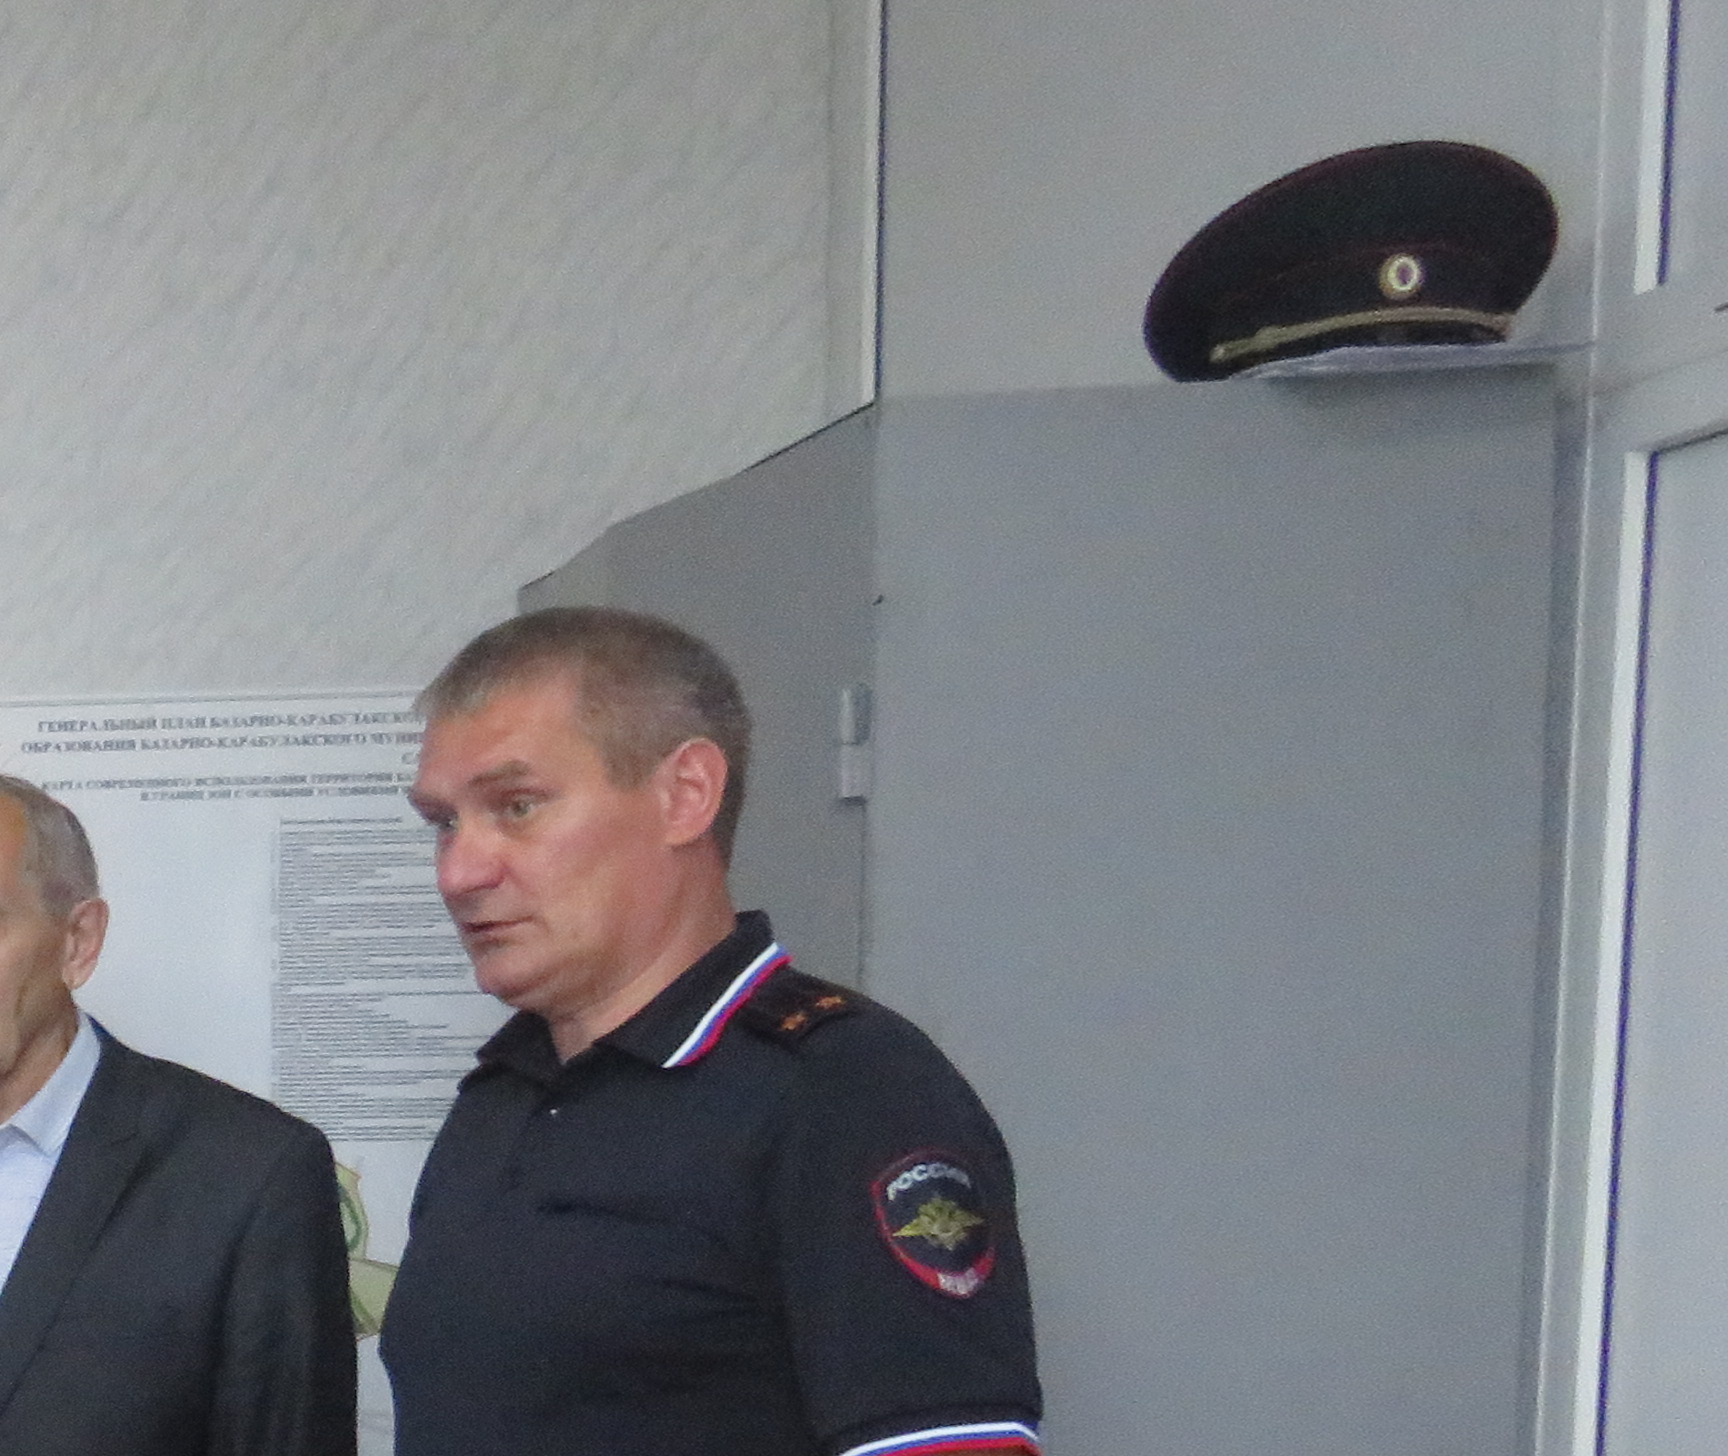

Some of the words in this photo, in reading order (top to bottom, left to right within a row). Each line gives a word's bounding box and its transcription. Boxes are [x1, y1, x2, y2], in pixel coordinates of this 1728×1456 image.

[38, 717, 157, 732] ГЕНЕРАЛЬНЫЙ
[161, 716, 206, 730] ПЛАН
[21, 738, 136, 753] ОБРАЗОВАНИЯ
